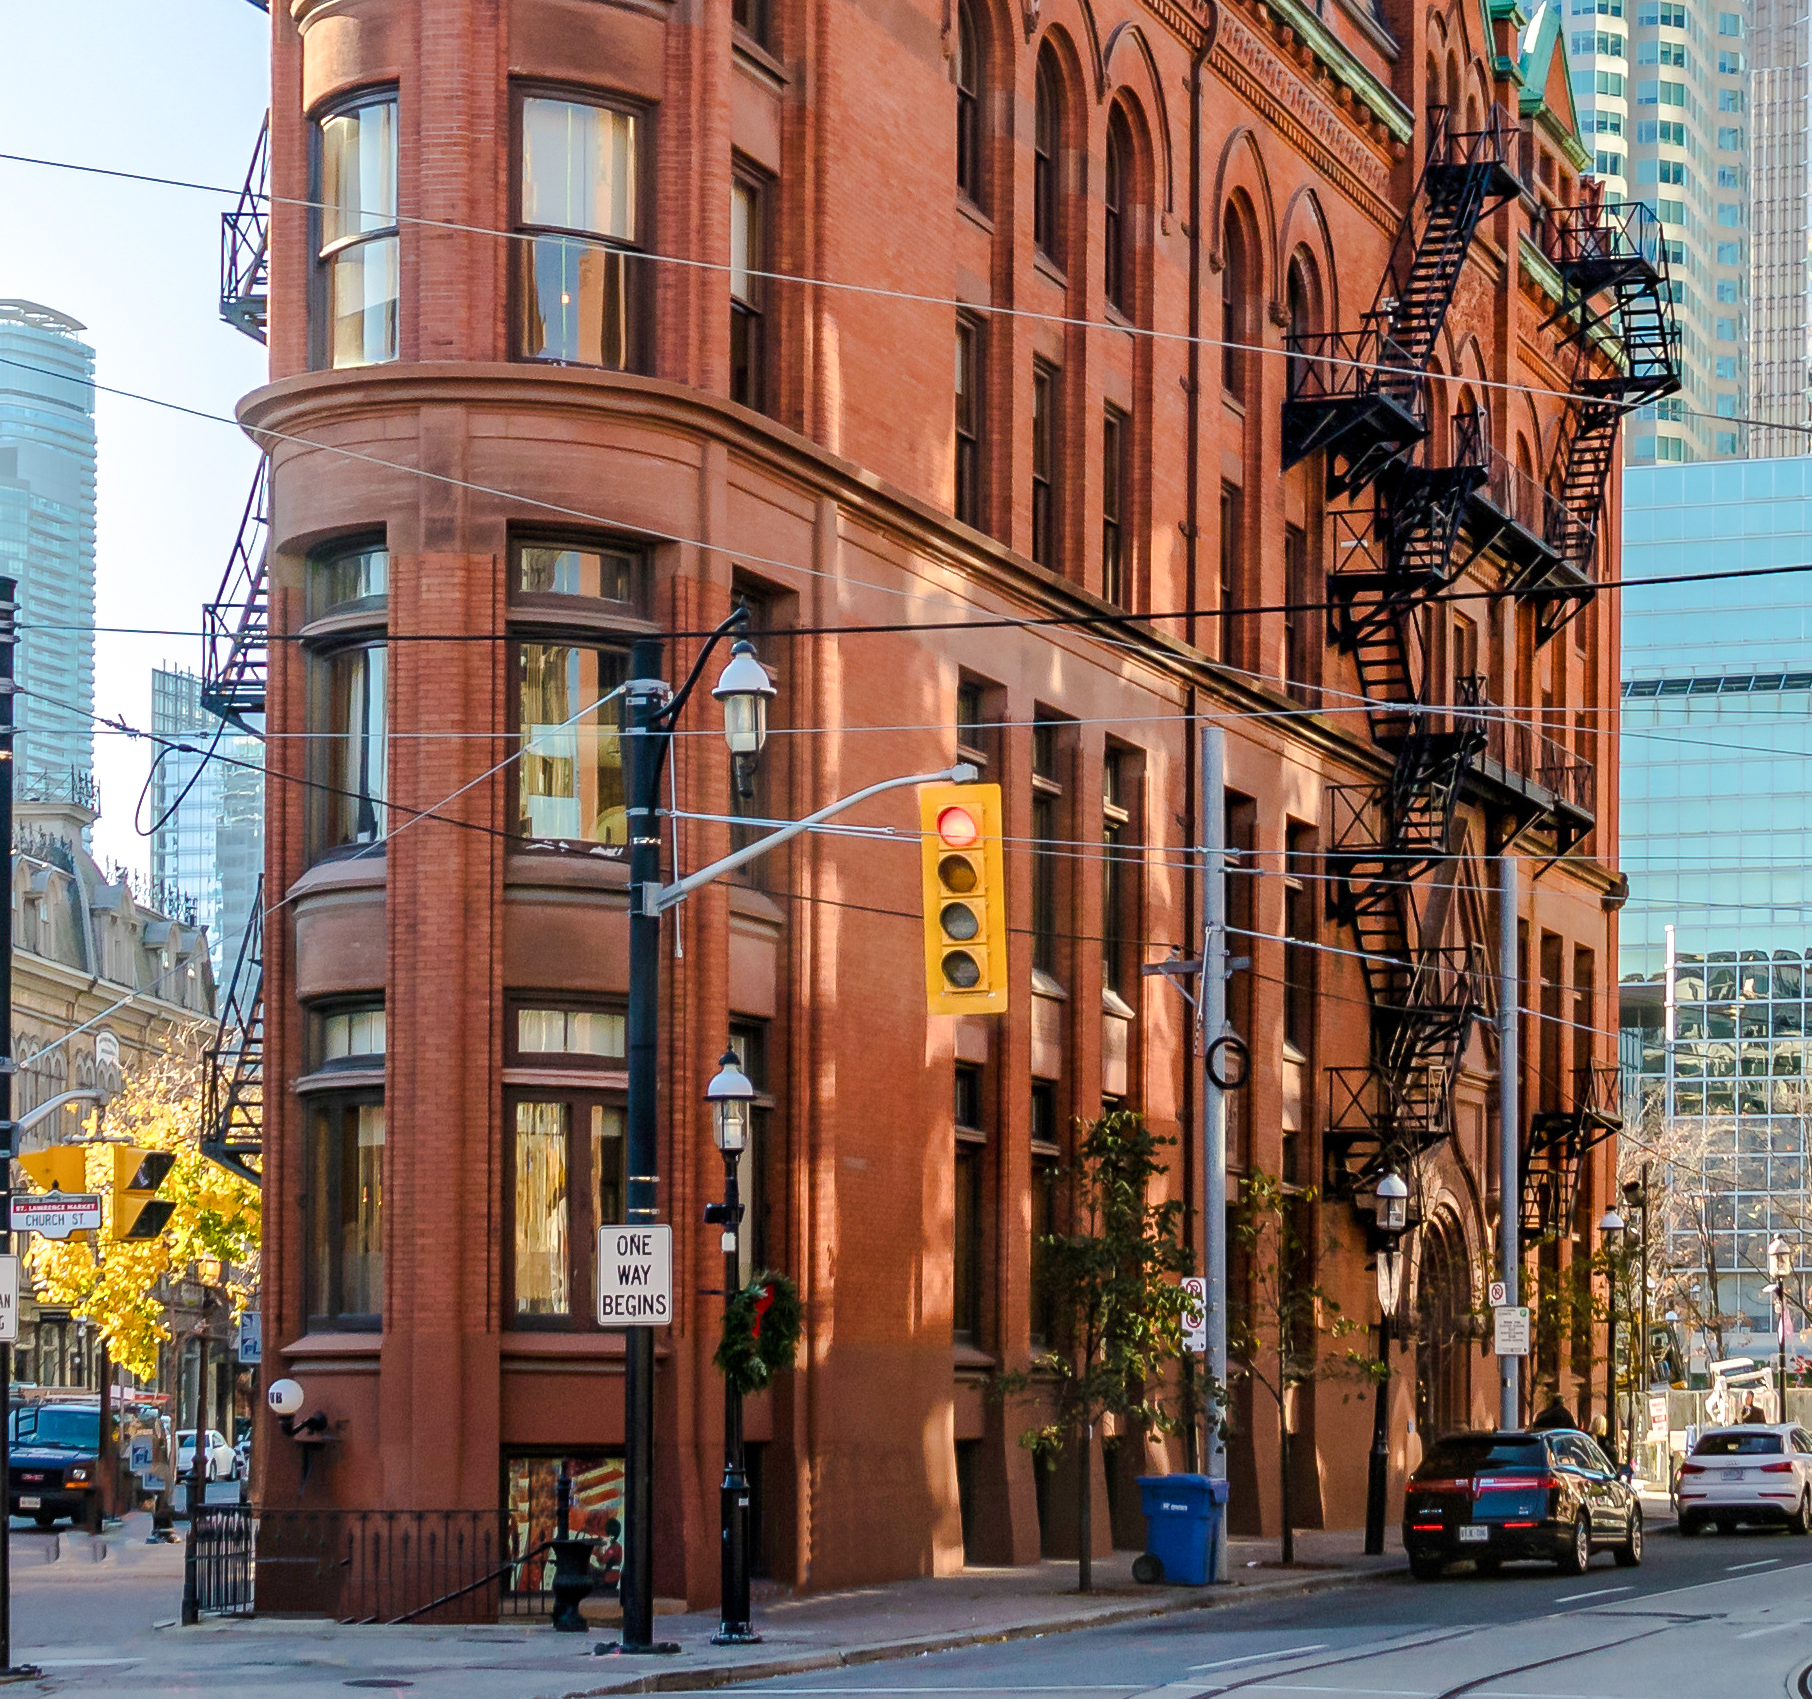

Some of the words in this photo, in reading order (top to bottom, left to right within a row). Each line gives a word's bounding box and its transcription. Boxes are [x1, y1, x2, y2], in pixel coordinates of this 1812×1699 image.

[25, 1214, 65, 1227] CHURCH
[616, 1234, 652, 1256] ONE
[617, 1264, 651, 1285] WAY
[602, 1293, 666, 1316] BEGINS
